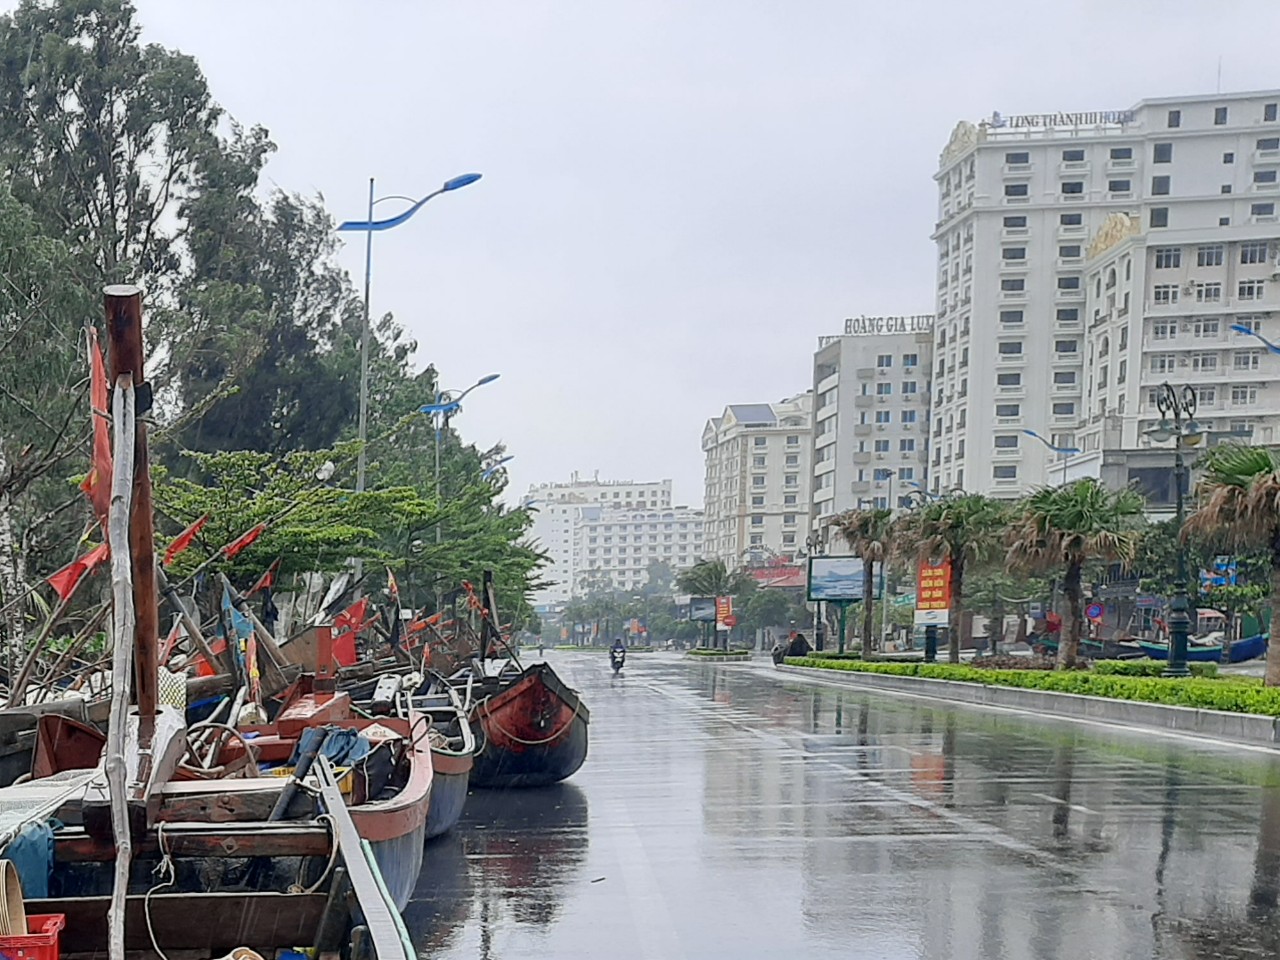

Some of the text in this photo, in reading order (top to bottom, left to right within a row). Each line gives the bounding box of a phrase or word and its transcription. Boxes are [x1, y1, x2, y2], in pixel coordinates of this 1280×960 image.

[1009, 114, 1039, 129] LONG
[1041, 111, 1083, 128] THÀNH
[844, 315, 883, 334] HOÀNG
[886, 316, 907, 332] GIA
